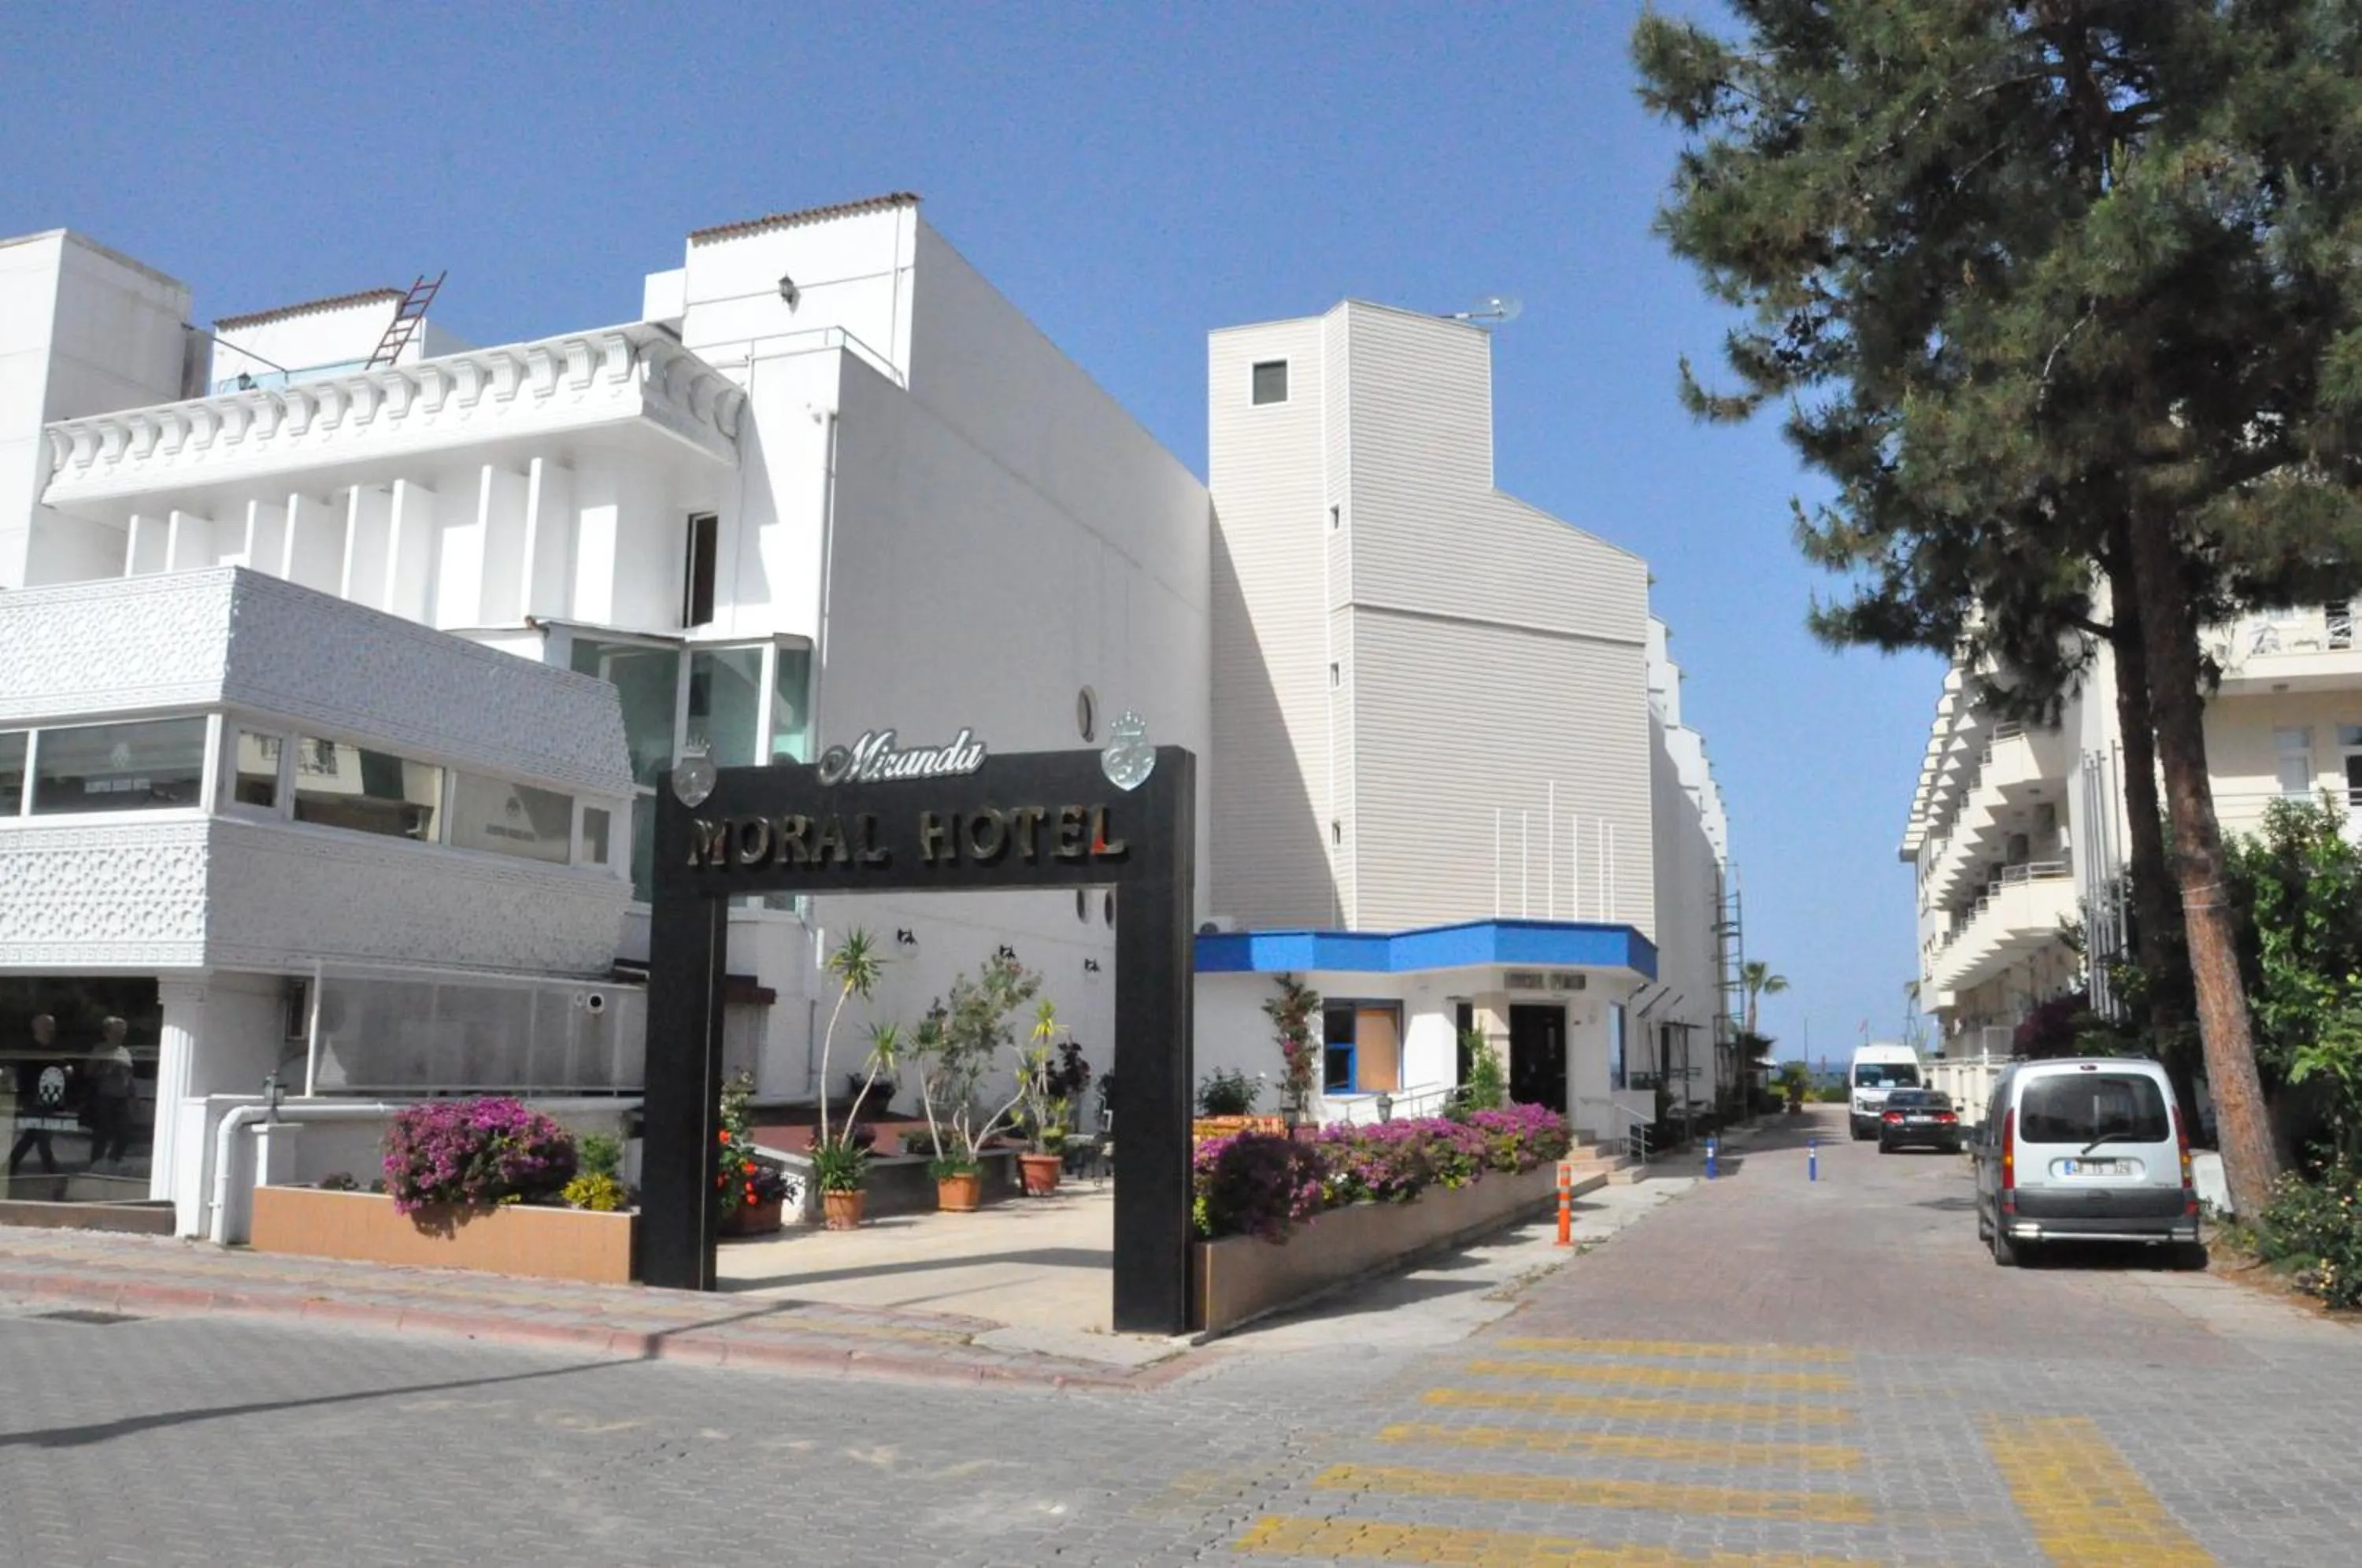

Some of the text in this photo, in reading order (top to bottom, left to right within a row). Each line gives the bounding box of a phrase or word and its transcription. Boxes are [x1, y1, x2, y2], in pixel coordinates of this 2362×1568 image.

[819, 727, 984, 786] Miranda
[687, 803, 1126, 865] MORAL HOTEL
